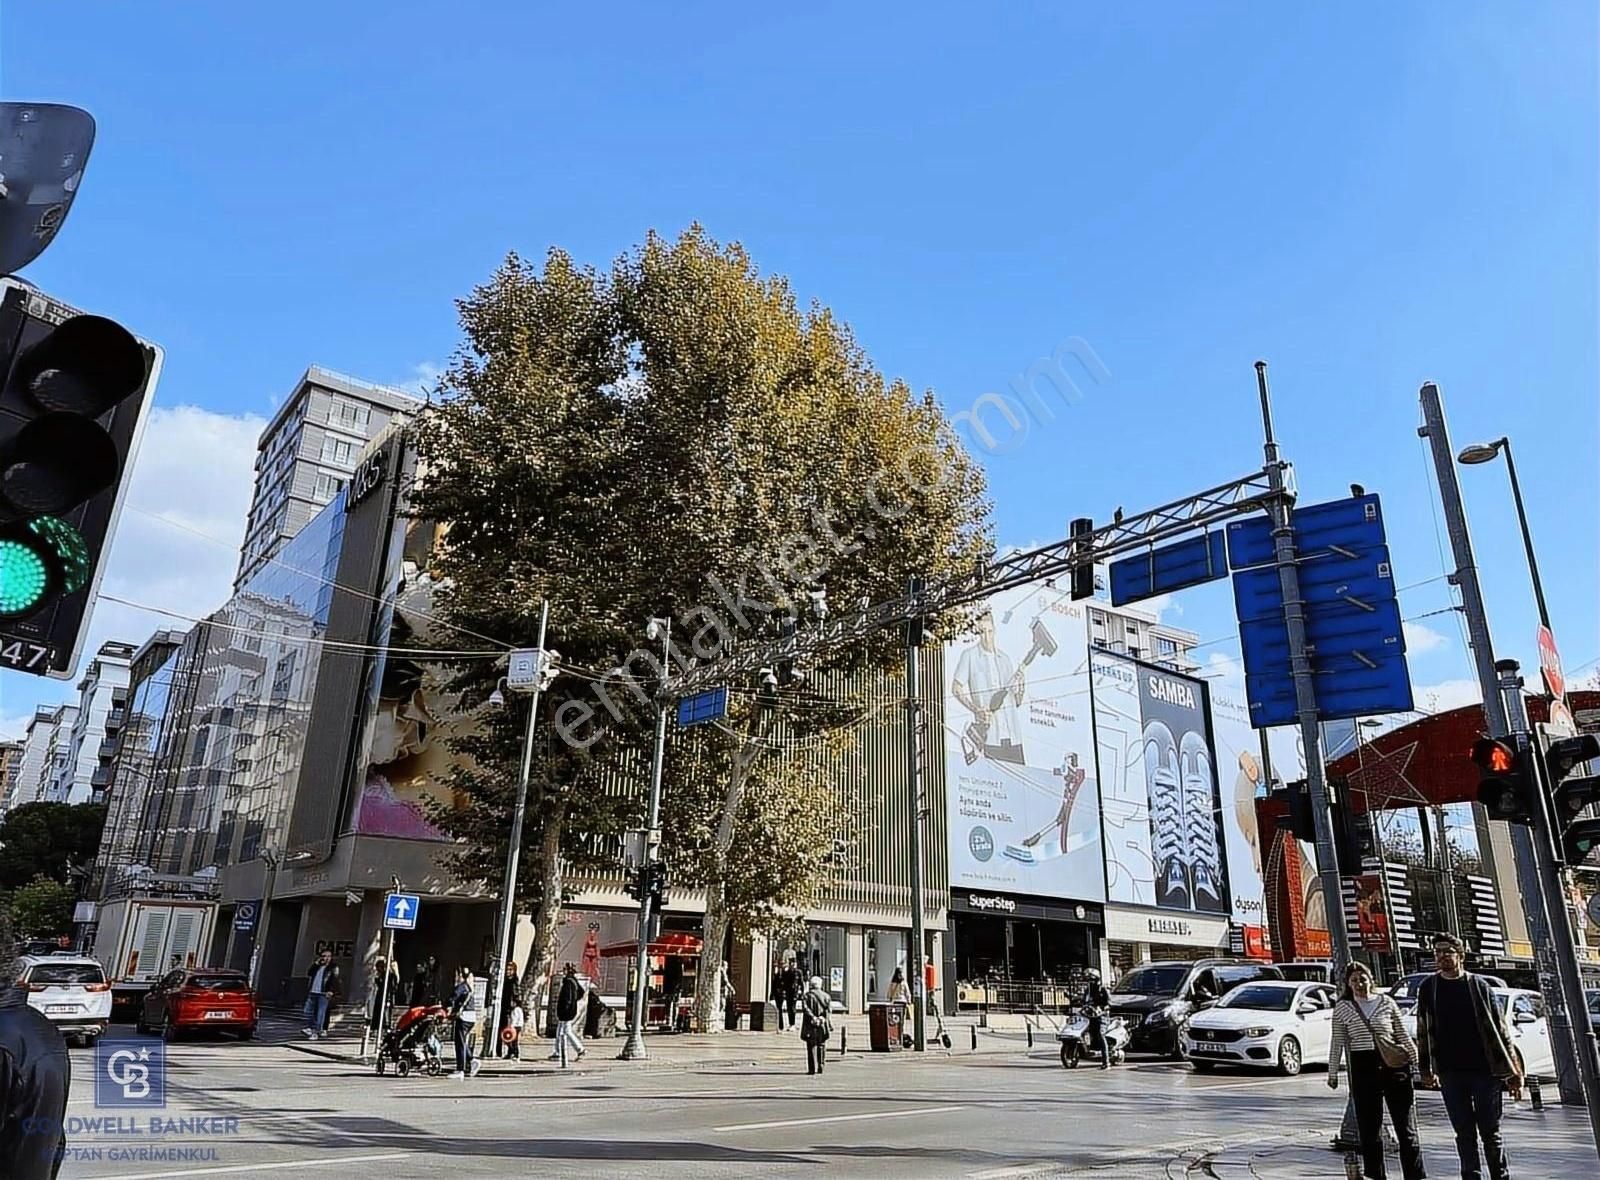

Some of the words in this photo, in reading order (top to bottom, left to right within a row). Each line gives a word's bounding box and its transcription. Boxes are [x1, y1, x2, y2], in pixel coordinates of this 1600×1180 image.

[1051, 602, 1081, 619] BOSCH
[0, 638, 47, 668] 47
[1149, 676, 1196, 710] SAMBA
[969, 894, 1016, 913] SuperStep
[1235, 896, 1260, 914] dyson
